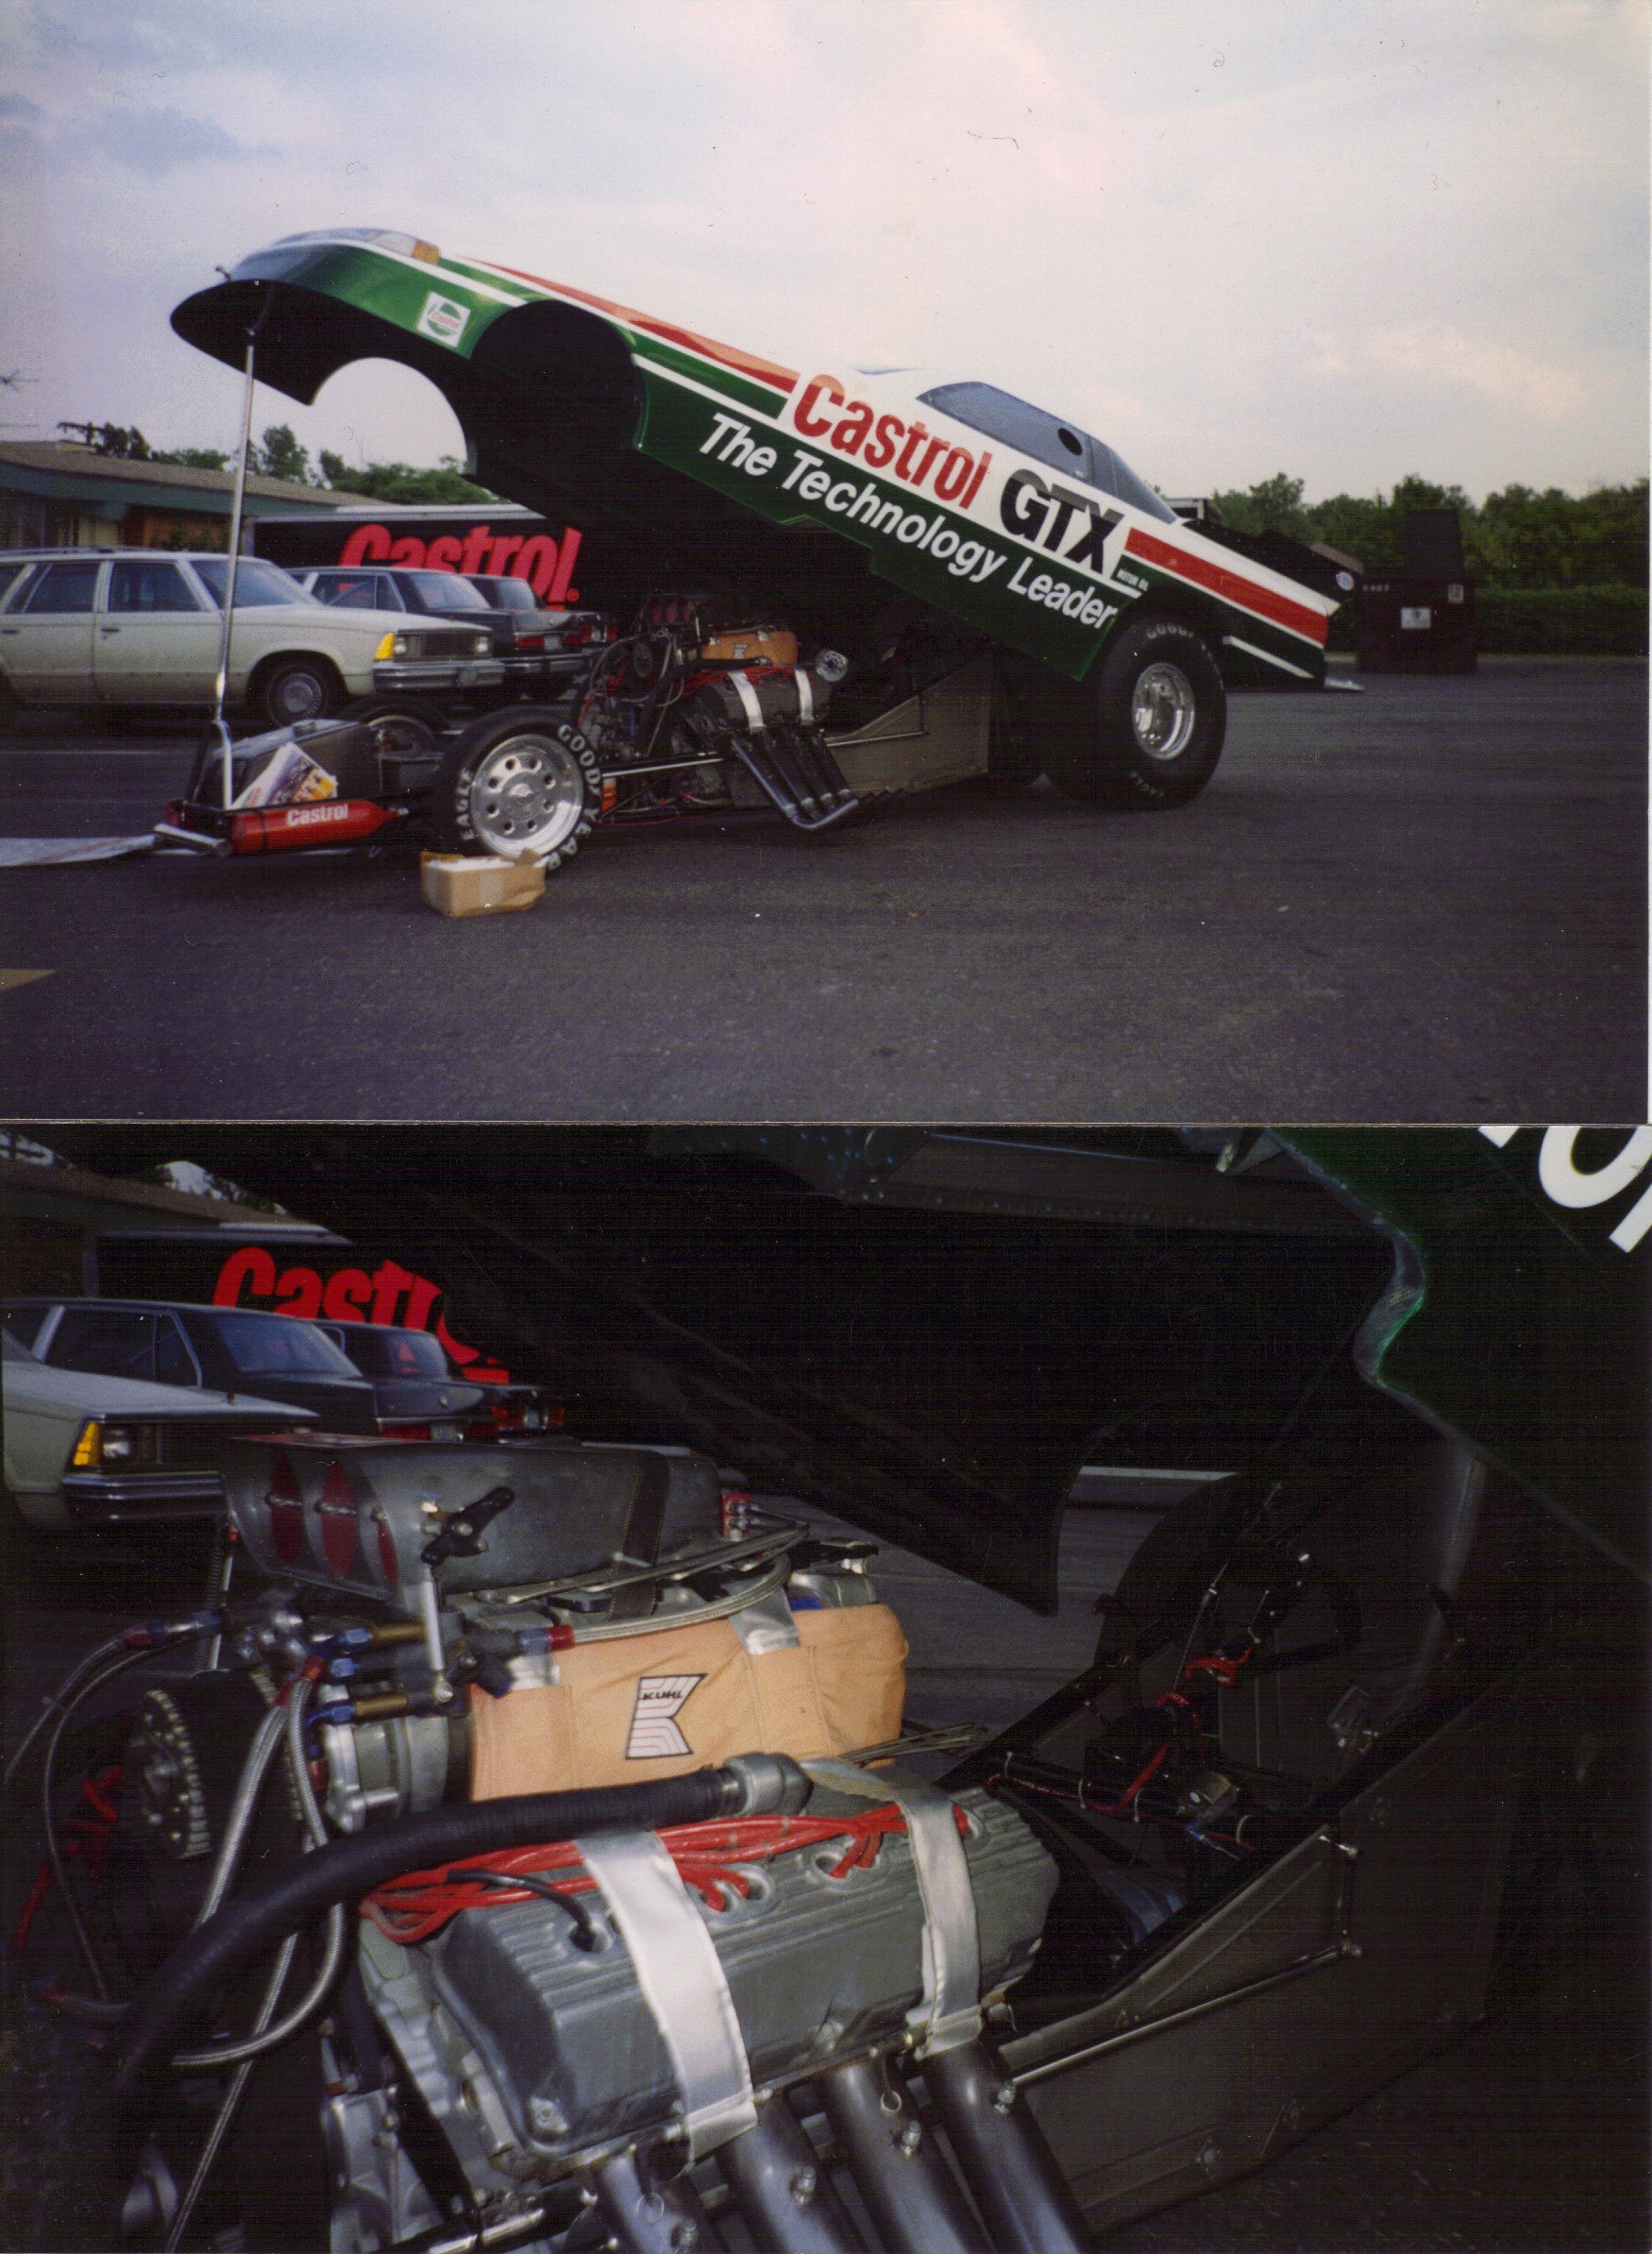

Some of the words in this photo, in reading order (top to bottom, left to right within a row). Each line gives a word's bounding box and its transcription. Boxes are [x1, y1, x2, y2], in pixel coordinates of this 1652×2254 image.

[700, 412, 778, 476] The
[782, 449, 1007, 583] Technology
[1006, 556, 1119, 630] Leader
[793, 374, 993, 510] Castrol
[1000, 468, 1125, 574] GTX
[286, 804, 348, 826] Castrol
